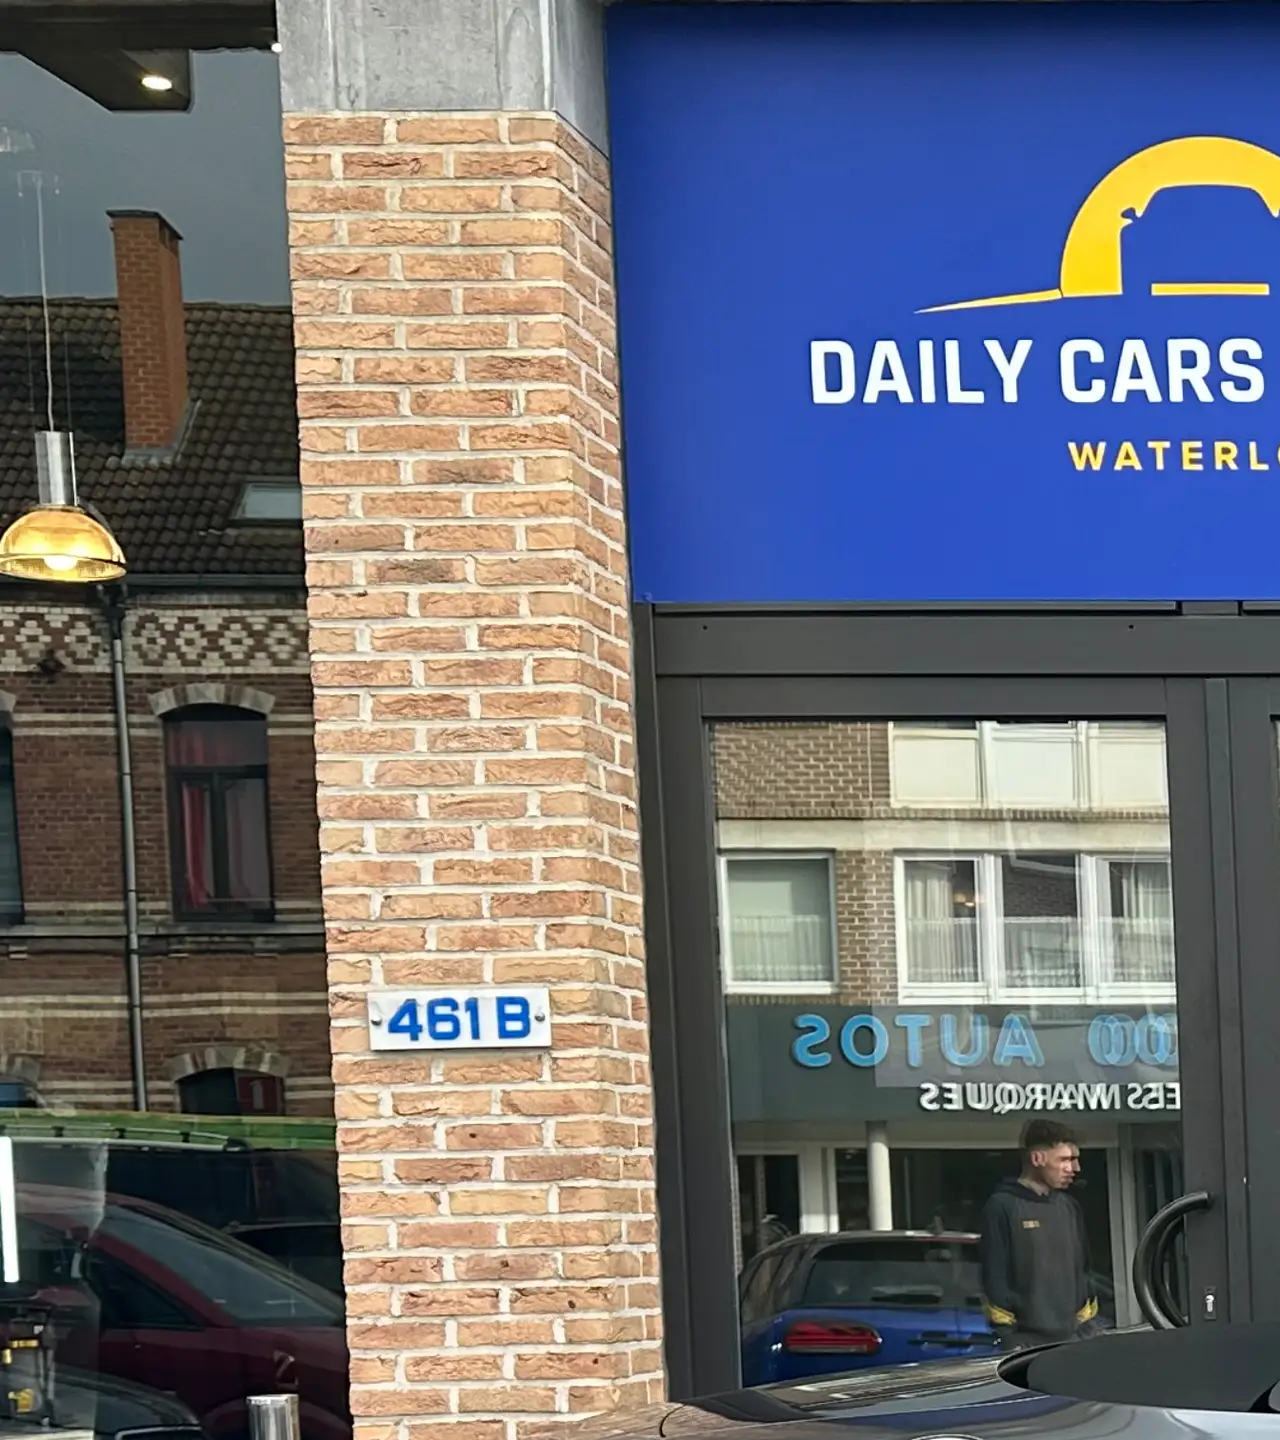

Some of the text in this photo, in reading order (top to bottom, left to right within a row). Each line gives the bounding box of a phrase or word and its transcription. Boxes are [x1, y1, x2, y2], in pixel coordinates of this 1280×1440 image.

[810, 339, 1033, 404] DAILY
[1060, 338, 1265, 403] CARS
[386, 995, 532, 1042] 461 B
